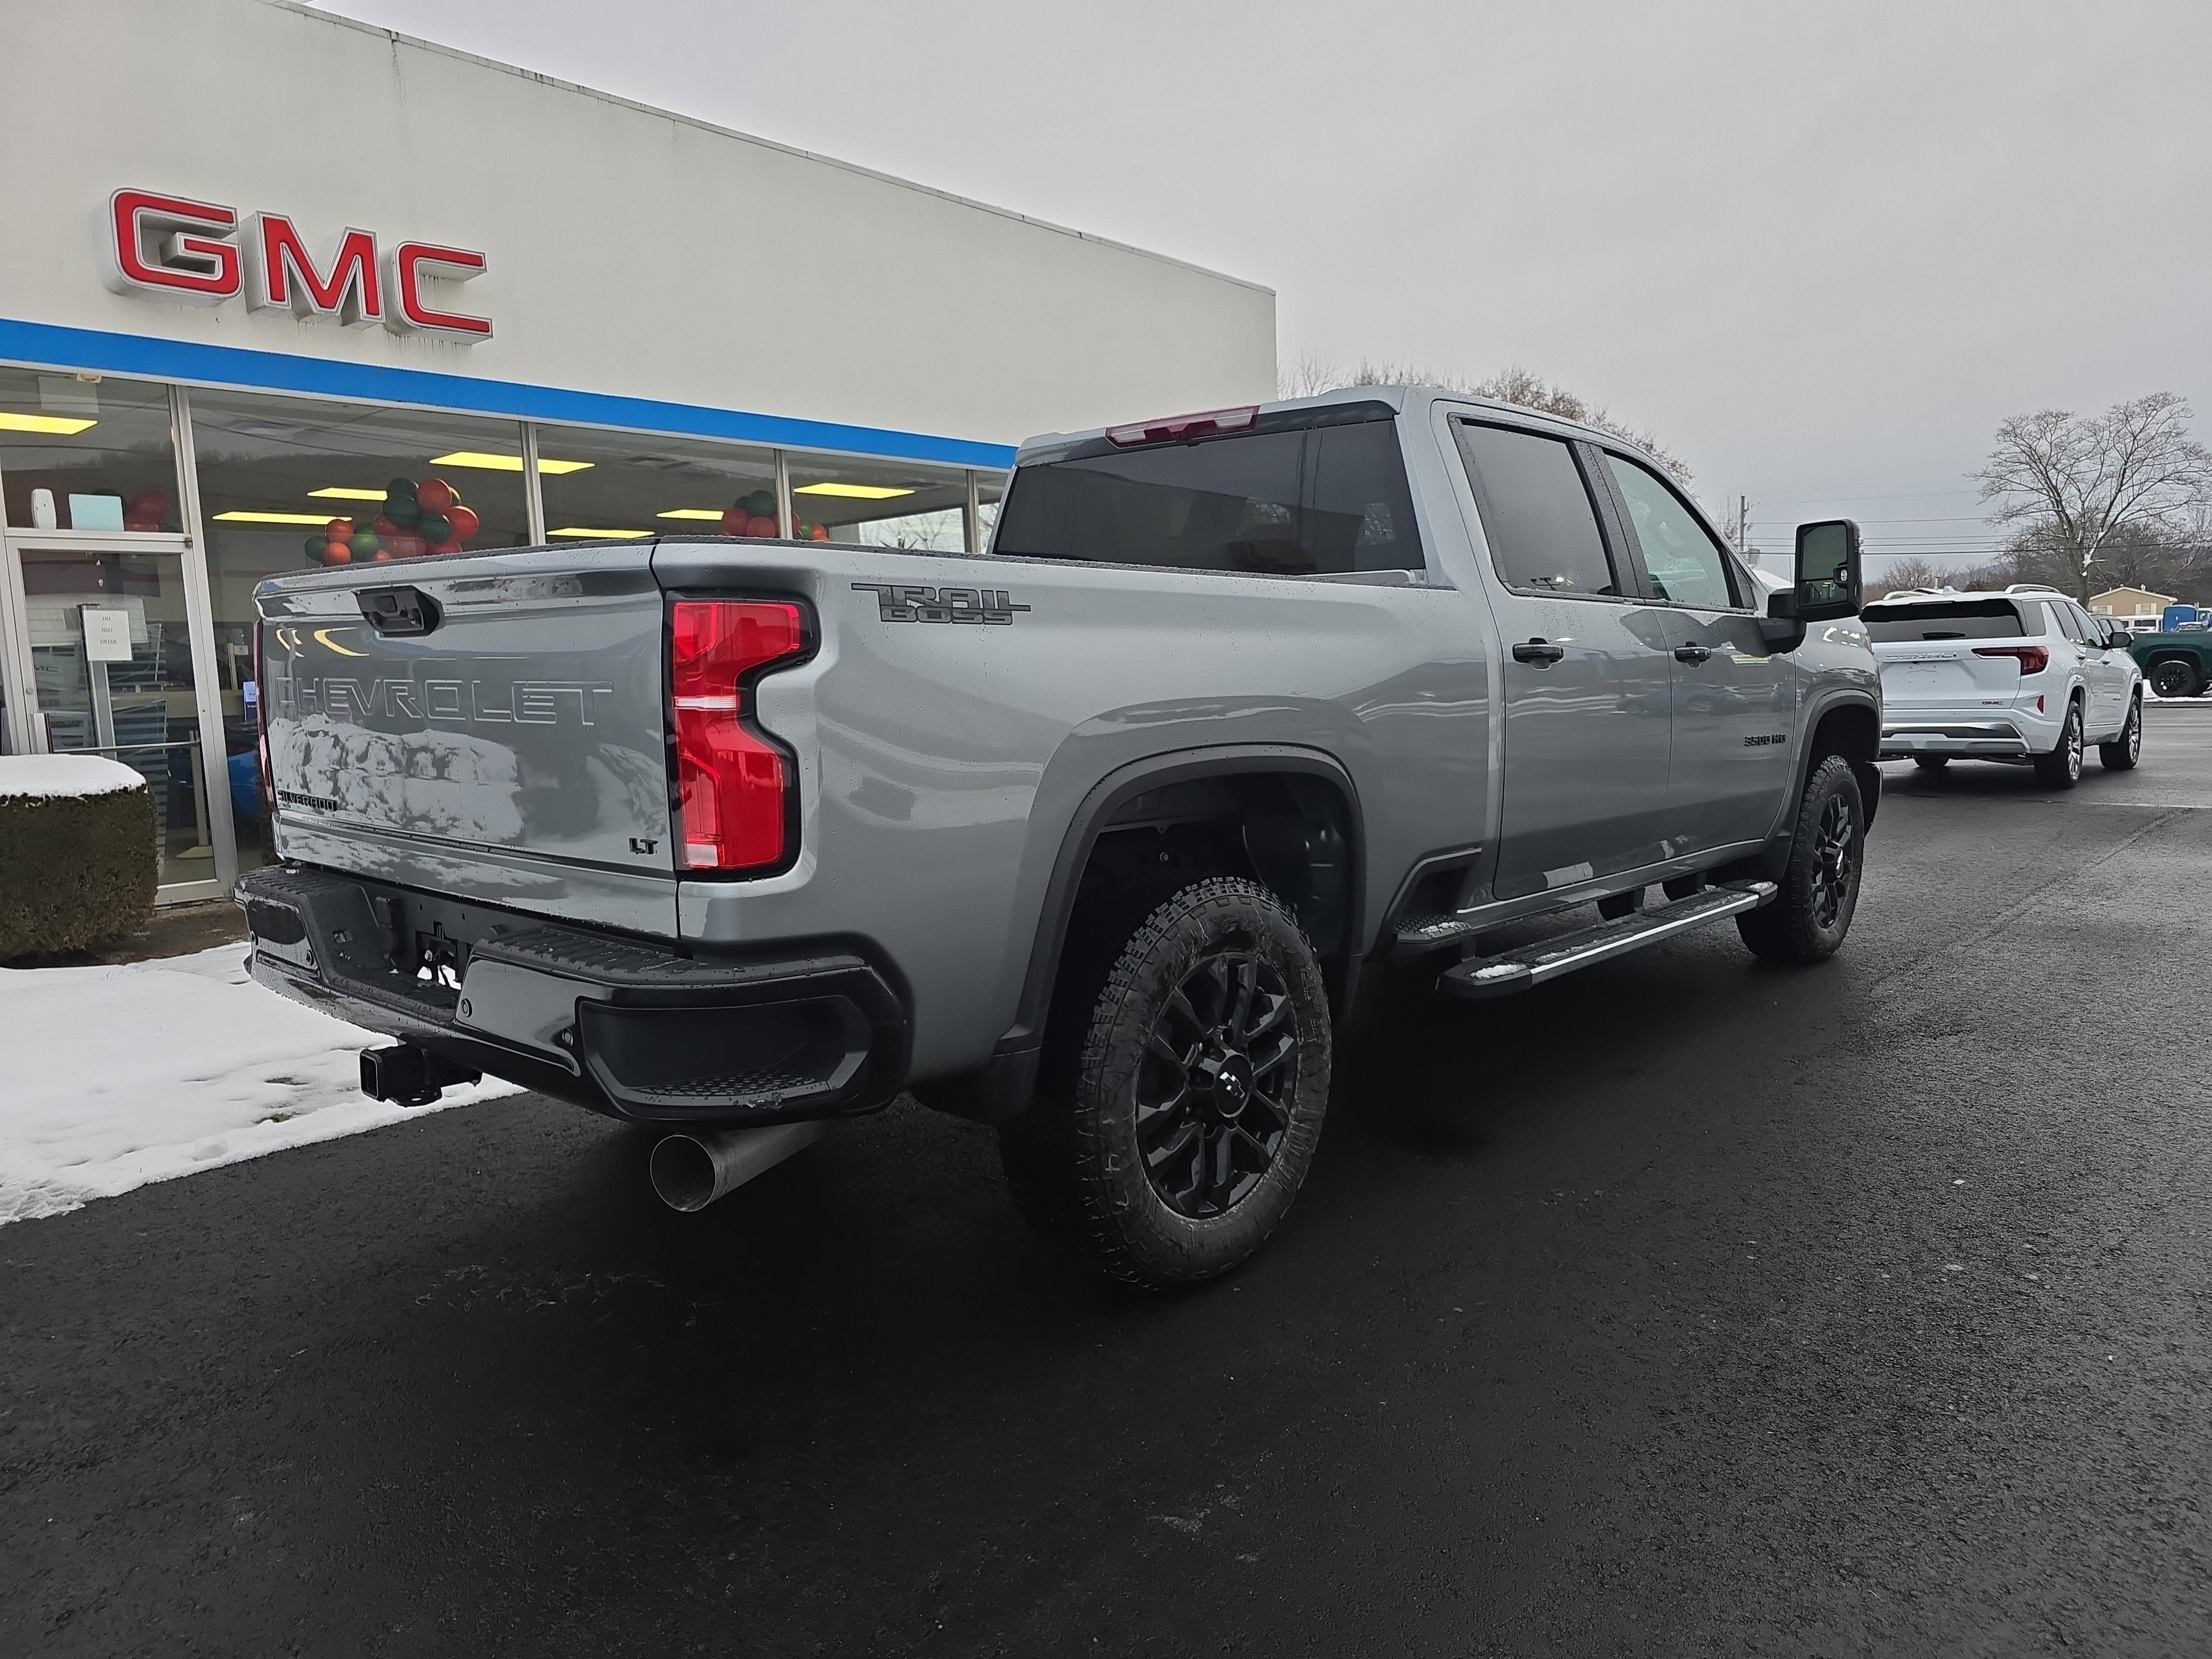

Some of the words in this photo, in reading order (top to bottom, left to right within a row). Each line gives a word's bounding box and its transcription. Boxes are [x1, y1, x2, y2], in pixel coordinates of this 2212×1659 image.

[110, 188, 493, 339] GMC
[851, 583, 1031, 612] TRAIL
[880, 605, 1013, 626] BOSS
[1886, 652, 1957, 660] DENALI
[275, 677, 612, 726] CHEVROLET
[1771, 734, 1786, 744] HD
[277, 790, 338, 812] SILVERADO
[629, 838, 659, 855] LT
